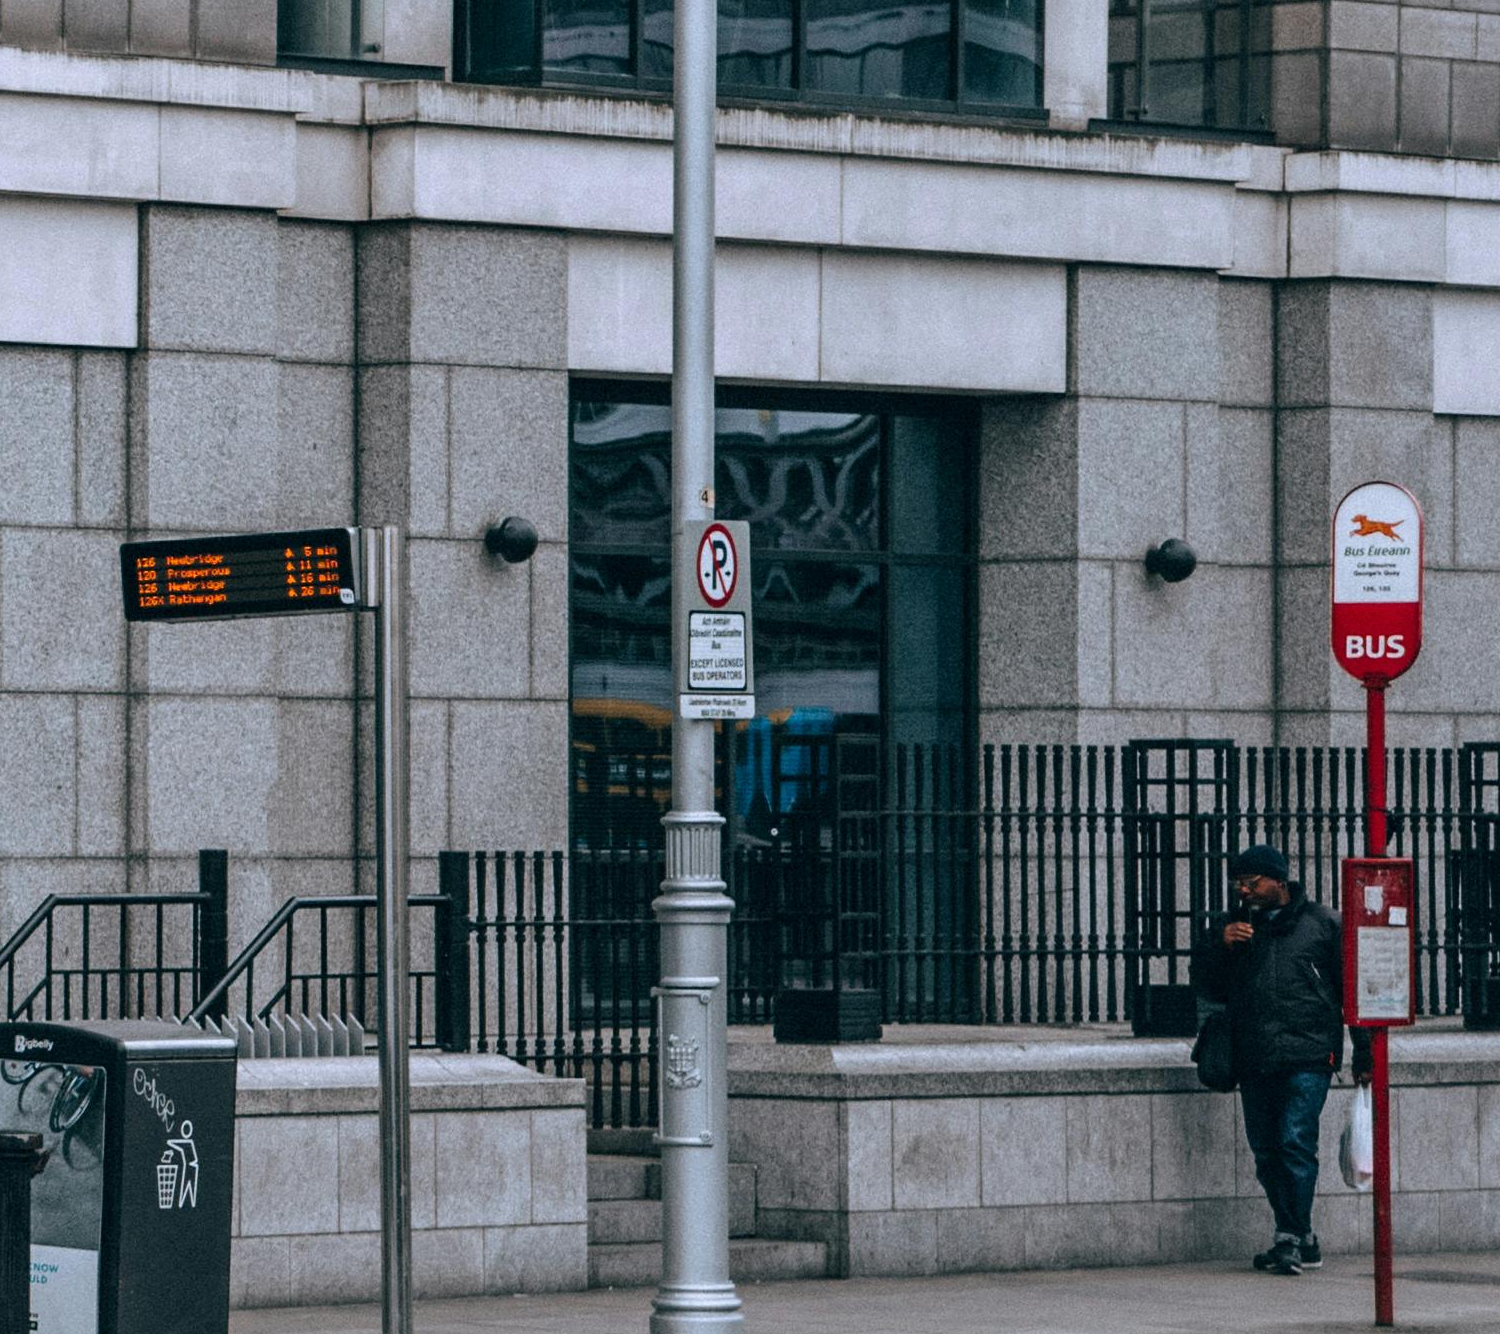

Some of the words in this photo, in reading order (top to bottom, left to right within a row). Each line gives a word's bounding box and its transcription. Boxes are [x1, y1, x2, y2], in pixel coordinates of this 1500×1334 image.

[701, 490, 709, 503] 4
[137, 557, 156, 568] 126
[166, 554, 224, 566] Newbridge
[316, 545, 338, 556] min
[1344, 546, 1365, 557] Bus
[1367, 544, 1411, 557] Éireann
[138, 570, 156, 581] 120
[167, 567, 231, 578] Prosperous
[300, 560, 312, 570] 11
[317, 559, 338, 569] min
[139, 583, 158, 594] 126
[168, 580, 226, 591] Newbridge
[318, 572, 340, 582] min
[169, 594, 226, 604] Rathangan
[319, 585, 340, 595] min
[1346, 634, 1405, 659] BUS
[691, 658, 714, 668] EXCEPT
[714, 658, 743, 668] LICENSED
[692, 671, 705, 681] BUS
[706, 671, 743, 681] OPERATORS
[14, 1034, 54, 1053] Bigbelly
[29, 1262, 60, 1273] NOW
